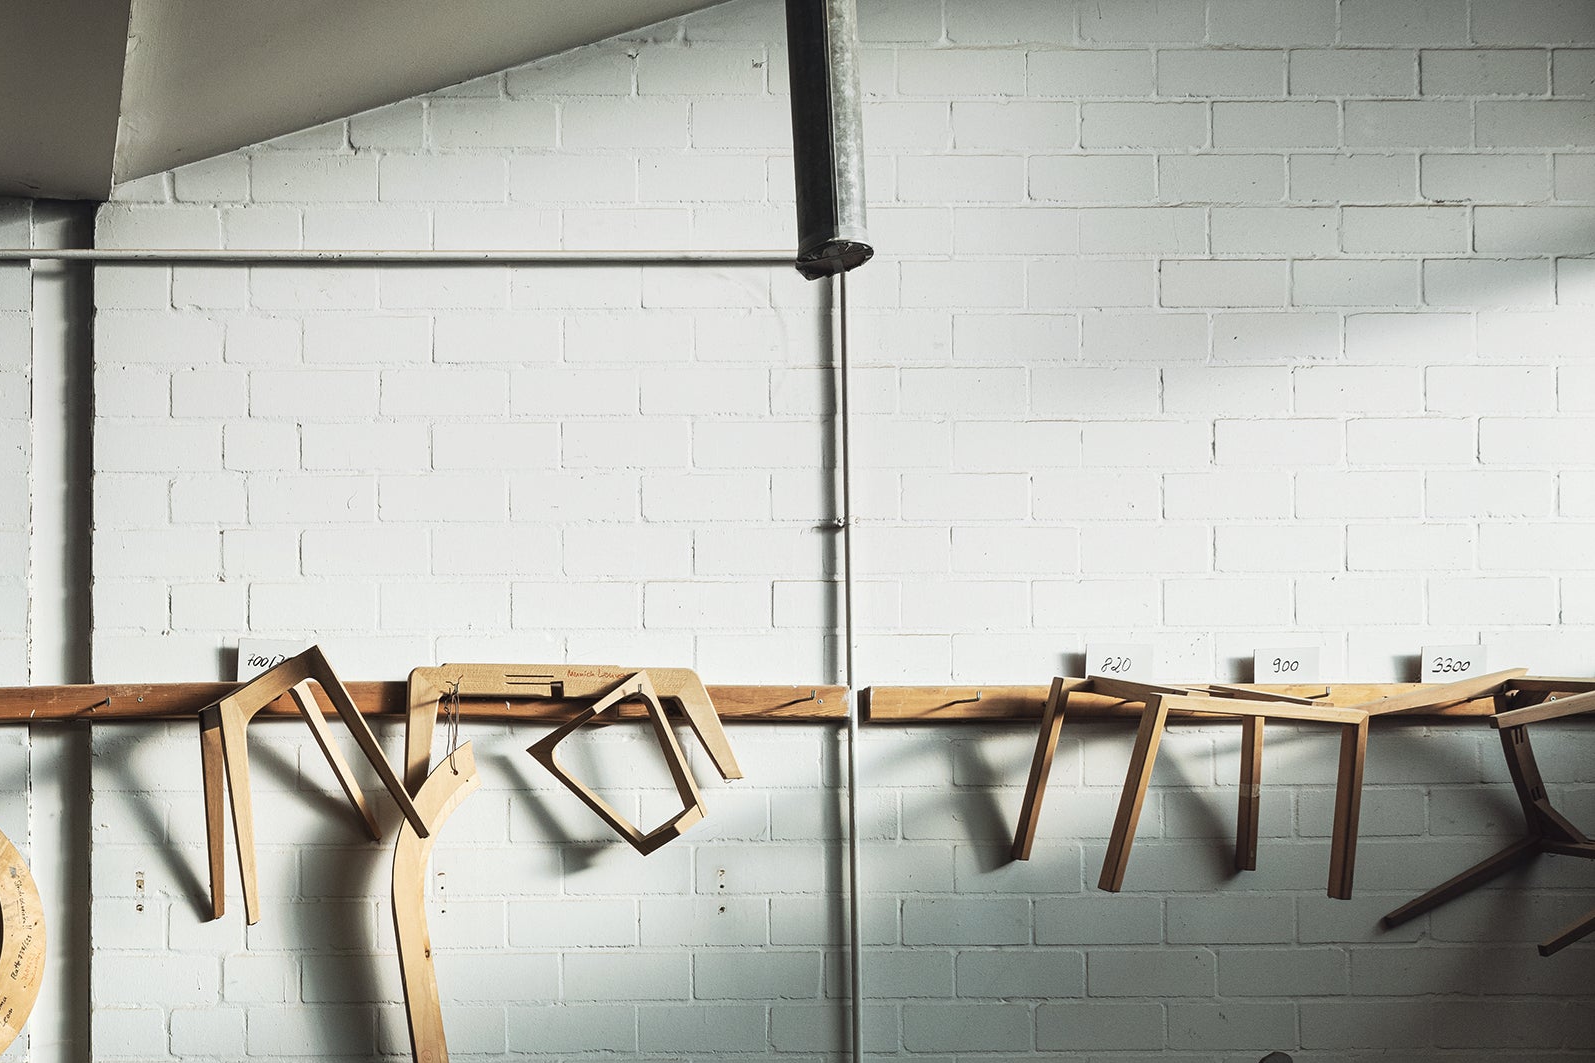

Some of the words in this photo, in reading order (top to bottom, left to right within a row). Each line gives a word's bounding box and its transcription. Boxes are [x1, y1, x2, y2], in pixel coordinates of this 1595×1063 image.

[1100, 657, 1132, 673] 820
[1273, 658, 1299, 673] 900
[1432, 656, 1471, 673] 3300
